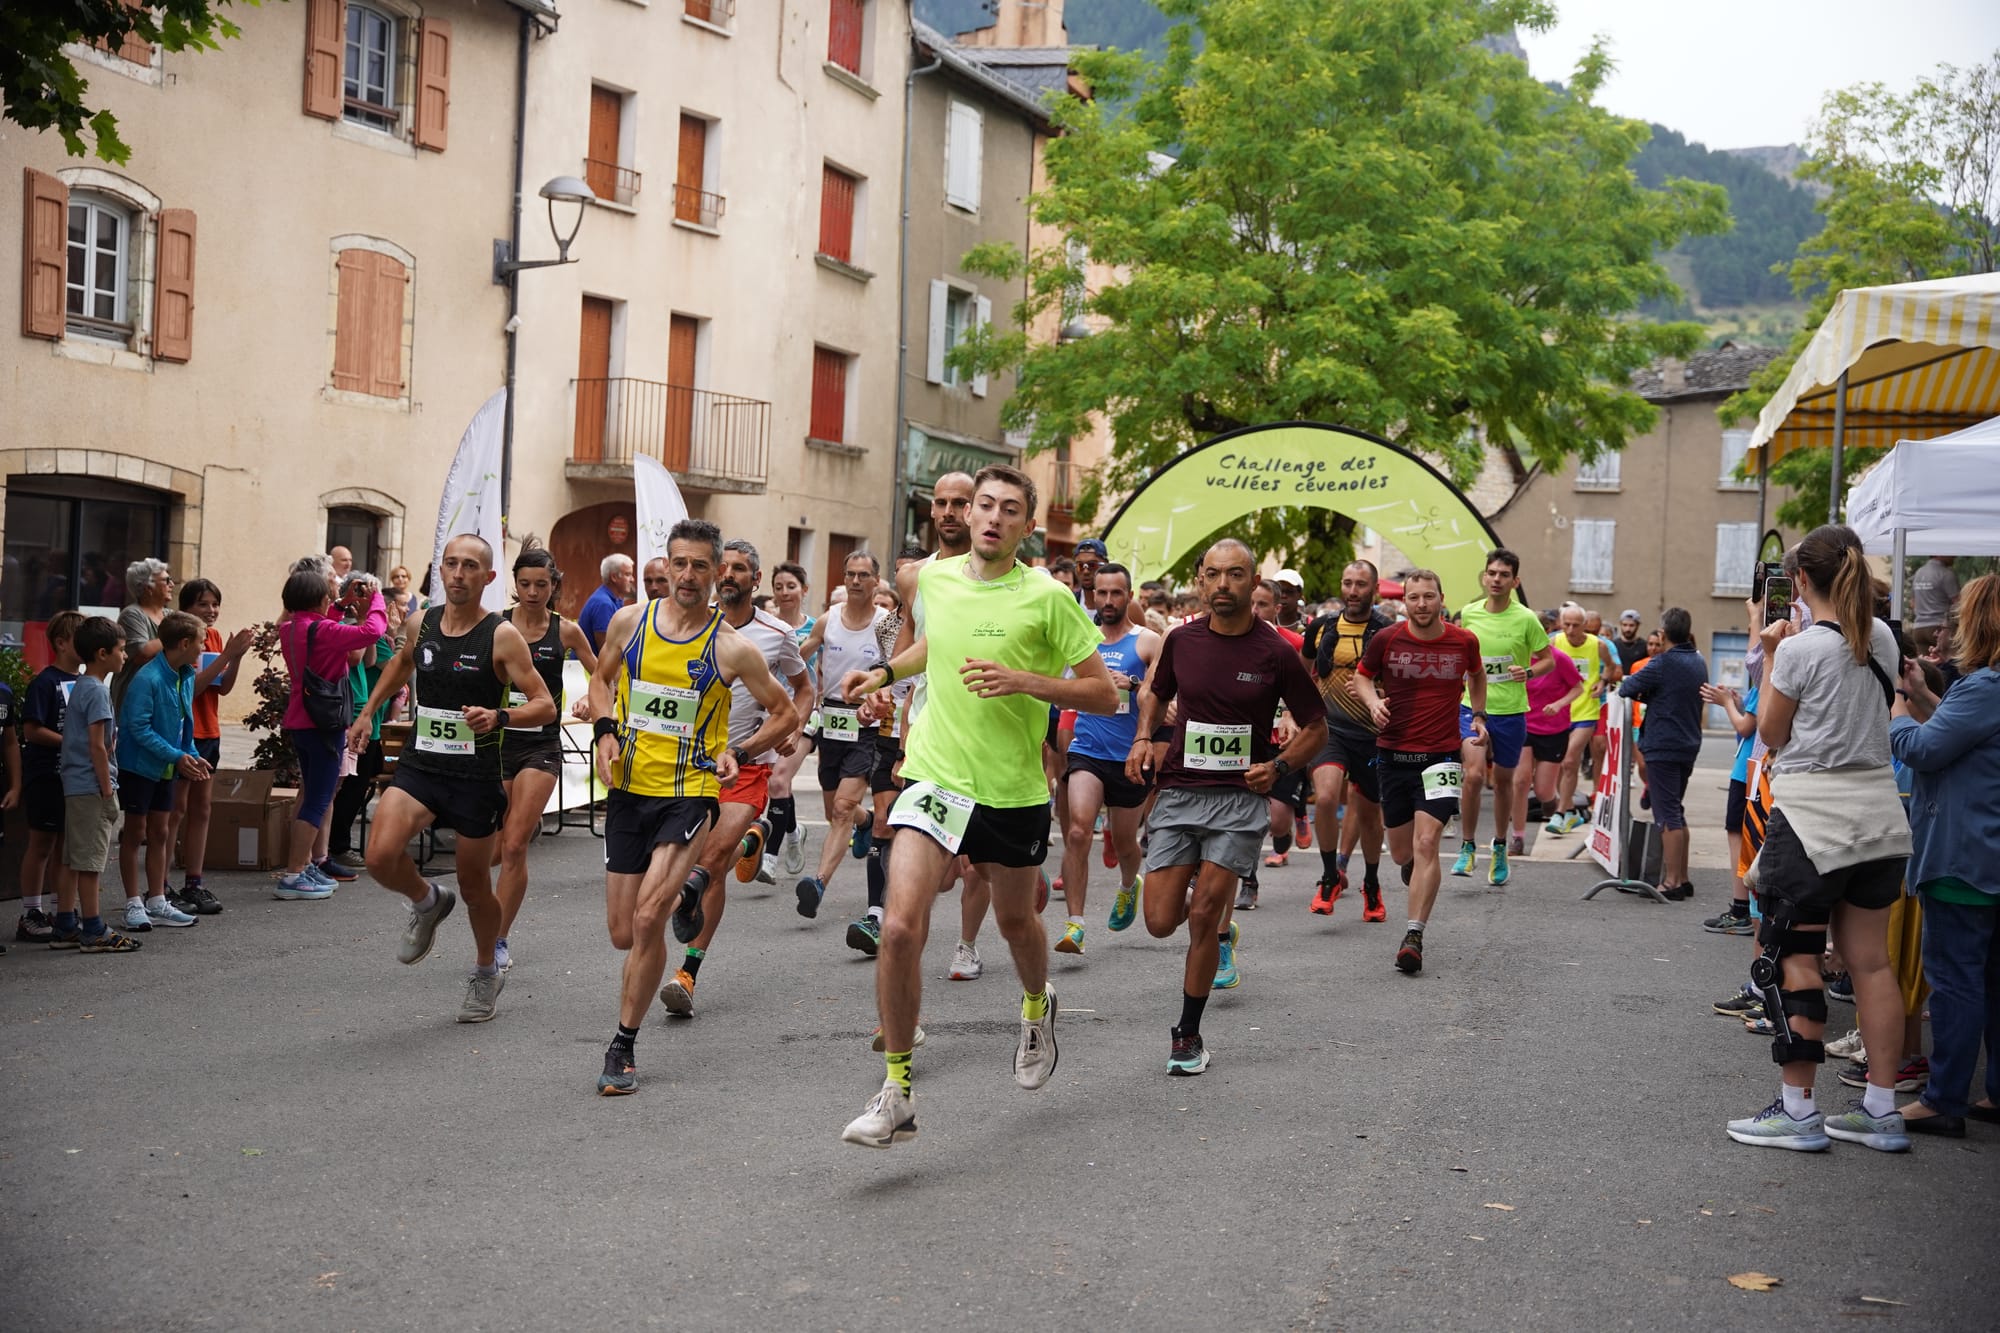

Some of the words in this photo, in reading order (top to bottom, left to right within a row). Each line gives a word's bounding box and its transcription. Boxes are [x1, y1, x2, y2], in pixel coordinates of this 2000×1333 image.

[1220, 454, 1326, 478] Challenge
[1341, 456, 1376, 471] des
[1206, 475, 1281, 491] vallées
[1295, 475, 1388, 492] cévenoles
[1485, 664, 1502, 674] 21
[645, 697, 678, 719] 48
[430, 720, 457, 739] 55
[830, 716, 848, 729] 82
[1194, 736, 1242, 755] 104
[1436, 772, 1458, 786] 35
[913, 794, 948, 825] 43
